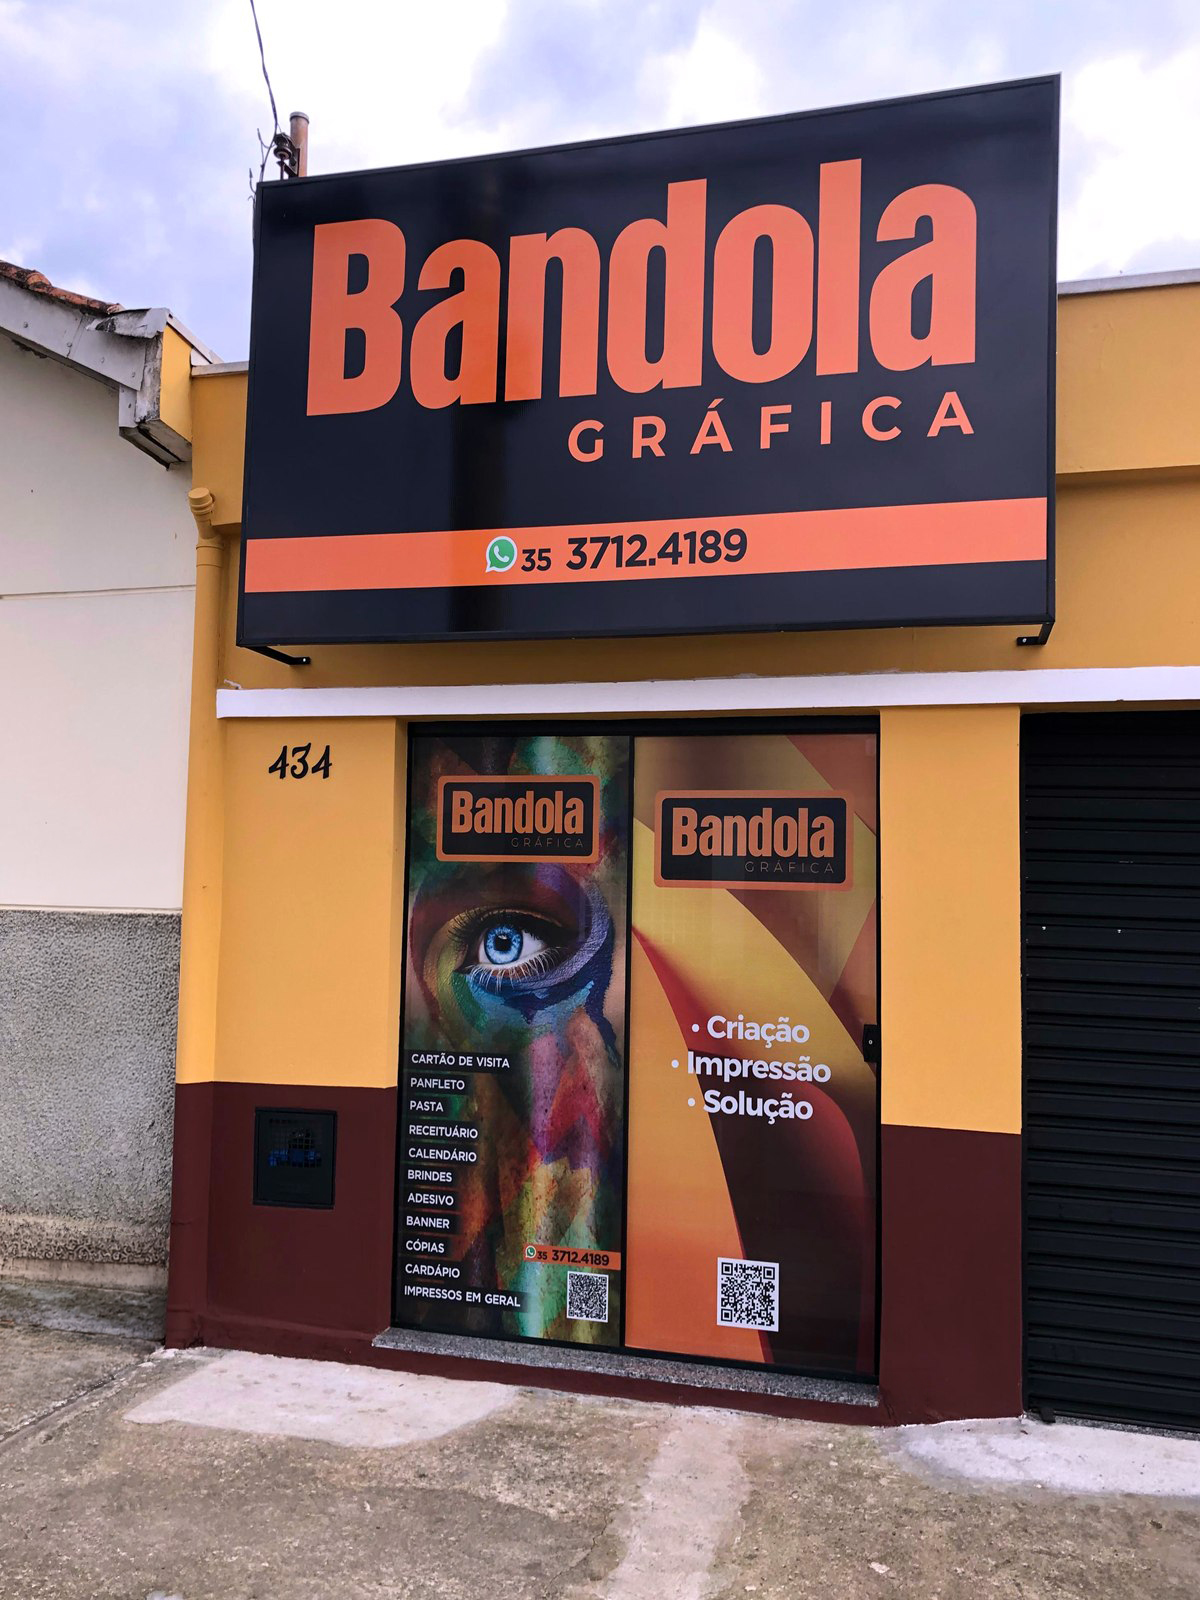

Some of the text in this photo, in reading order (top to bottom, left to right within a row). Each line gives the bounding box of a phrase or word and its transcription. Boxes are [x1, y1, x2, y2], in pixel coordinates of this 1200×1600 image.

[306, 158, 977, 417] Bandola
[567, 392, 975, 463] GRÁFICA
[521, 528, 748, 573] 35 3712.4189
[268, 743, 333, 780] 434
[452, 790, 584, 835] Bandola
[672, 808, 835, 858] Bandola
[511, 838, 584, 848] GRÁFICA
[745, 859, 835, 874] GRÁFICA
[707, 1014, 810, 1049] Criação
[411, 1053, 510, 1068] CARTÃO DE VISITA
[688, 1051, 832, 1083] Impressão
[410, 1078, 465, 1090] PANFLETO
[409, 1101, 444, 1112] PASTA
[704, 1090, 813, 1125] Solução
[409, 1125, 478, 1139] RECEITUÁRIO
[408, 1148, 477, 1162] CALENDÁRIO
[408, 1171, 452, 1183] BRINDES
[407, 1193, 454, 1206] ADESIVO
[406, 1216, 450, 1229] BANNER
[406, 1239, 445, 1253] CÓPIAS
[537, 1250, 609, 1266] 35 3712.4189
[405, 1263, 460, 1278] CARDÁPIO
[404, 1286, 521, 1307] IMPRESSOS EM GERAL
